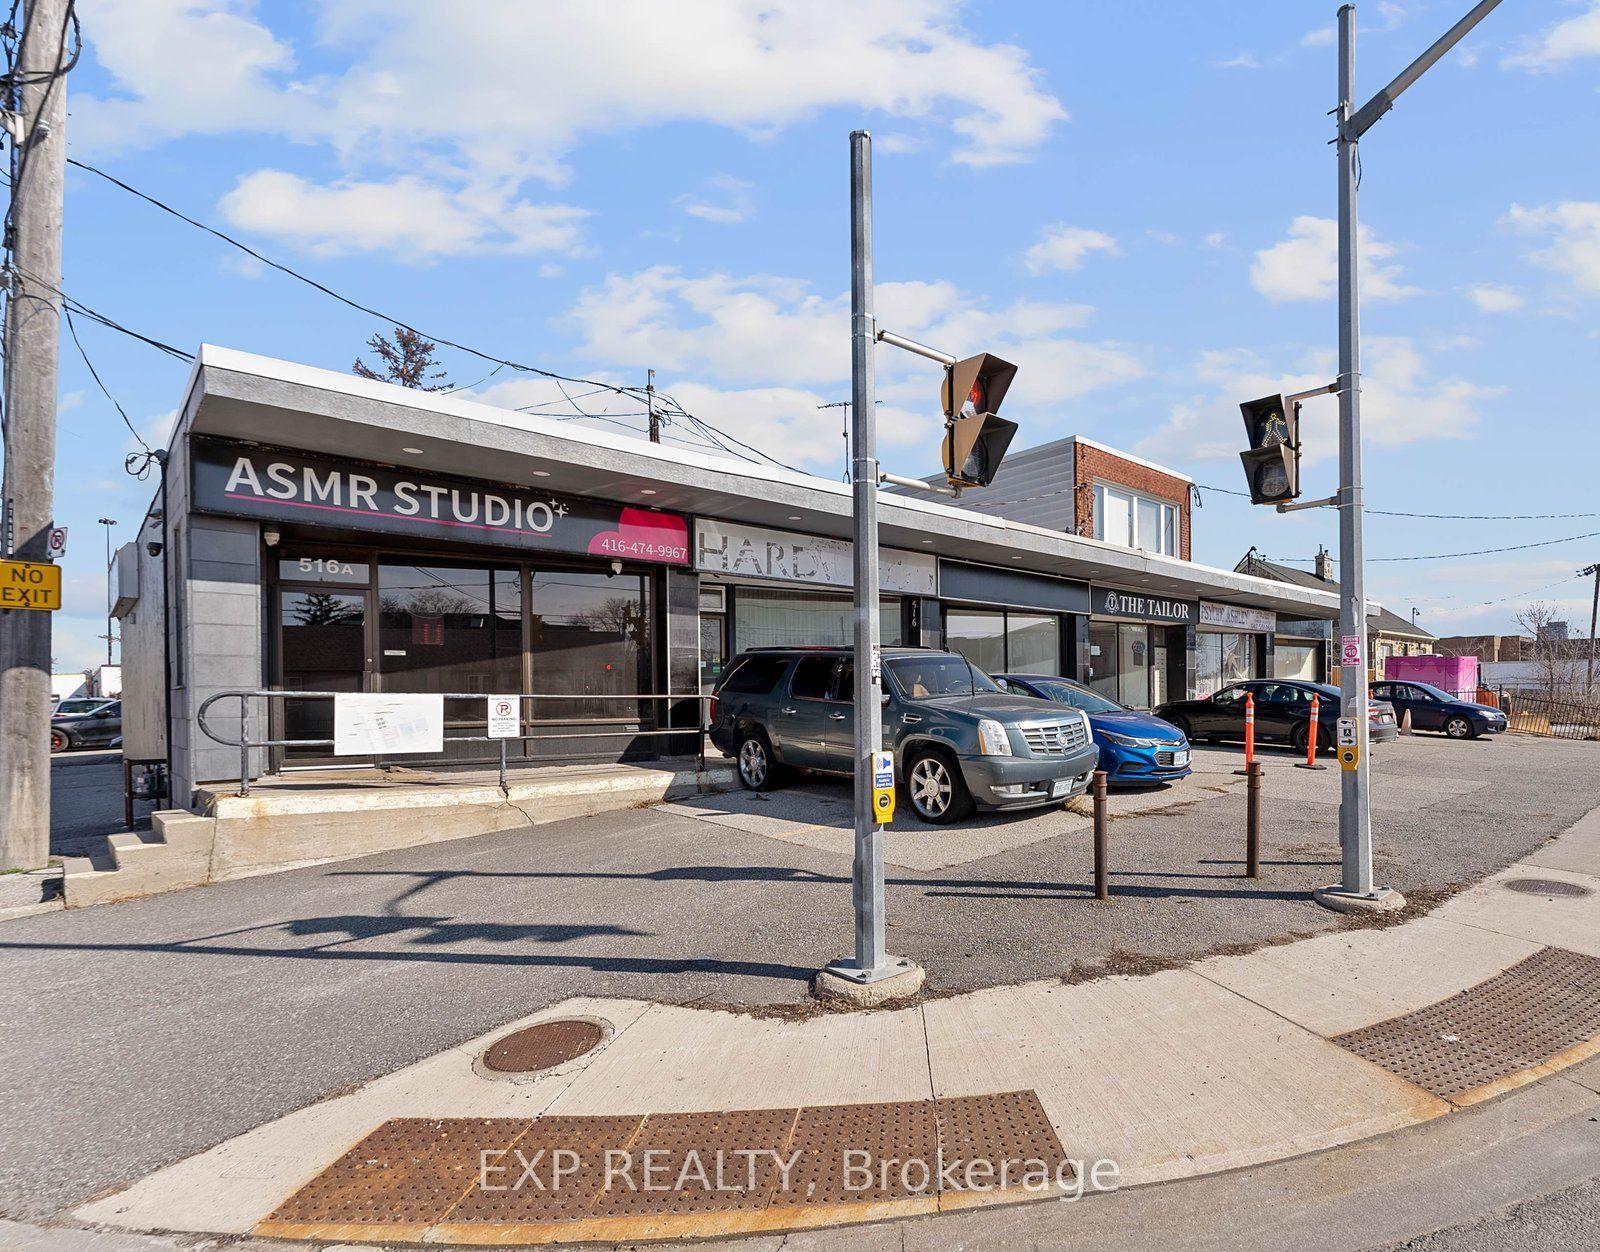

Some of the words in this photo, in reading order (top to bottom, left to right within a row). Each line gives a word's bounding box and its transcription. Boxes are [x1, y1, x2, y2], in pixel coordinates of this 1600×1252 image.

[224, 457, 379, 511] ASMR
[393, 481, 554, 532] STUDIO
[601, 538, 687, 560] 416-474-9967
[11, 568, 44, 584] NO
[299, 558, 353, 575] 516A
[2, 587, 52, 603] EXIT
[1119, 596, 1145, 614] THE
[1147, 599, 1189, 619] TAILOR
